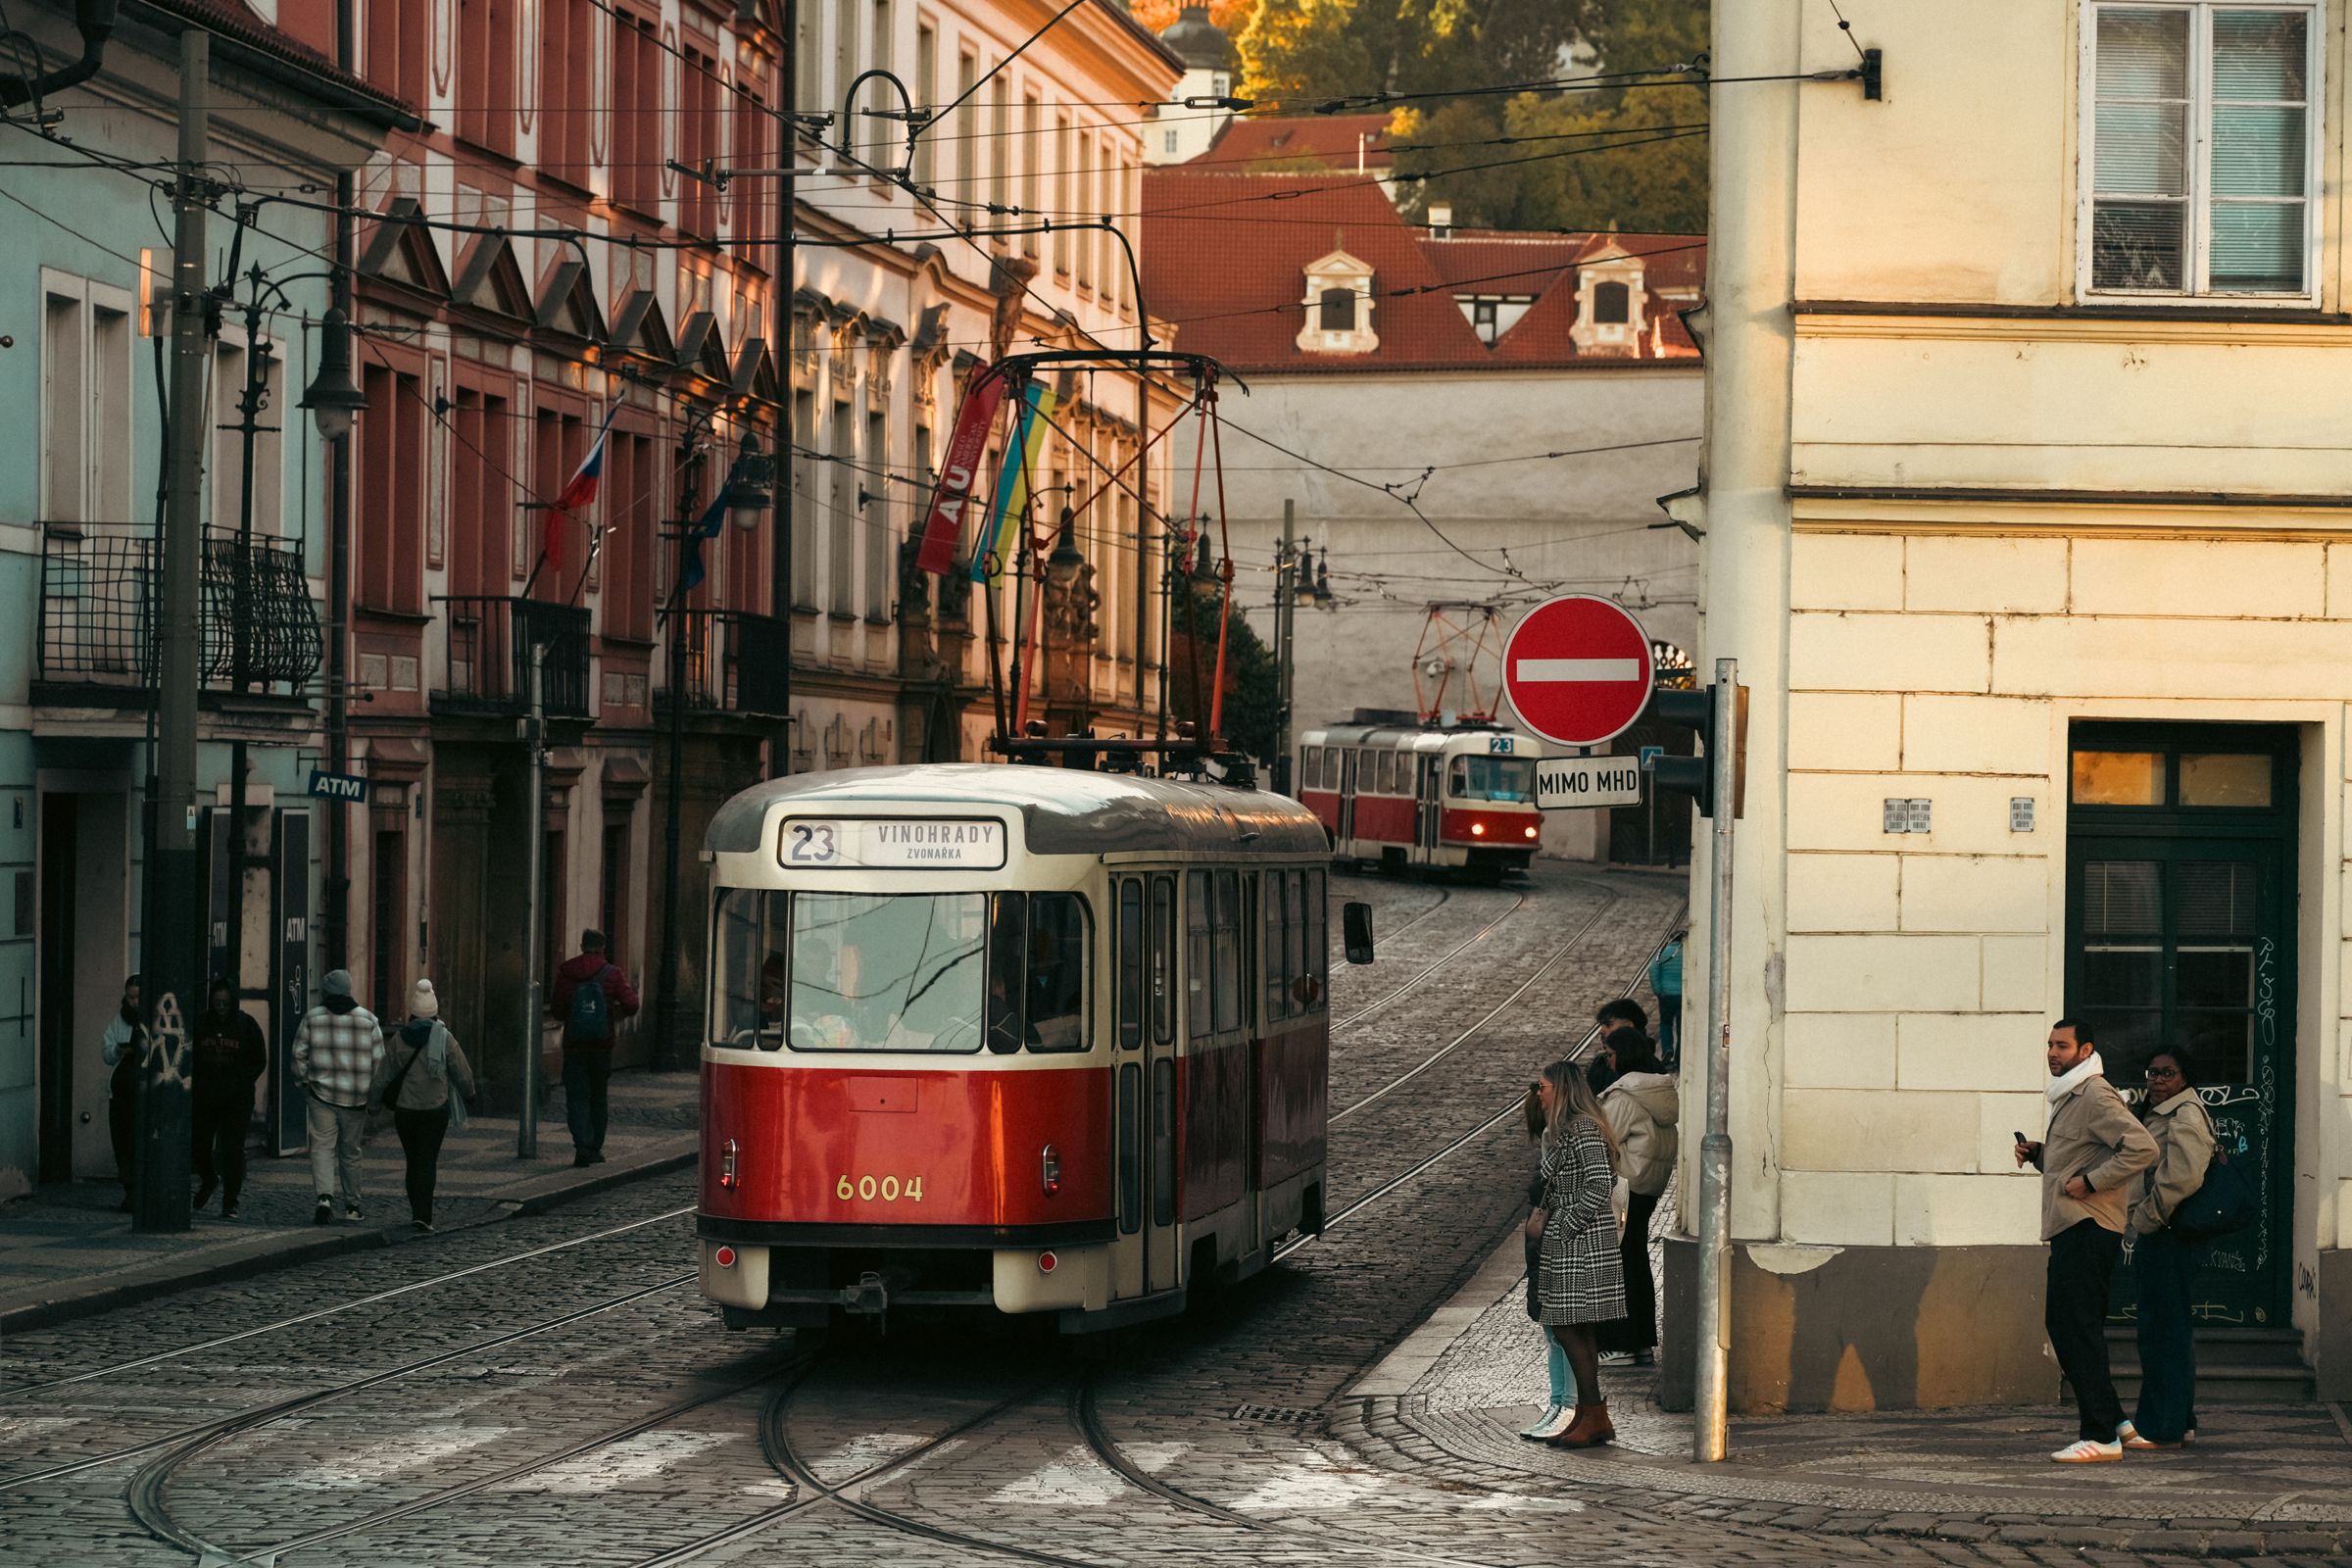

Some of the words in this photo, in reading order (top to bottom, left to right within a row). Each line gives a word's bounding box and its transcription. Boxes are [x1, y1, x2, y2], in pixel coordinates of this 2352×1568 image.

[1492, 738, 1512, 753] 23
[315, 776, 361, 798] ATM
[1539, 771, 1589, 796] MIMO
[1596, 769, 1637, 793] MHD
[791, 824, 834, 861] 23
[878, 825, 993, 844] VINOHRADY
[906, 847, 961, 859] ZVONAŘKA
[212, 921, 227, 948] ATM
[286, 917, 306, 942] ATM
[836, 1174, 923, 1202] 6004
